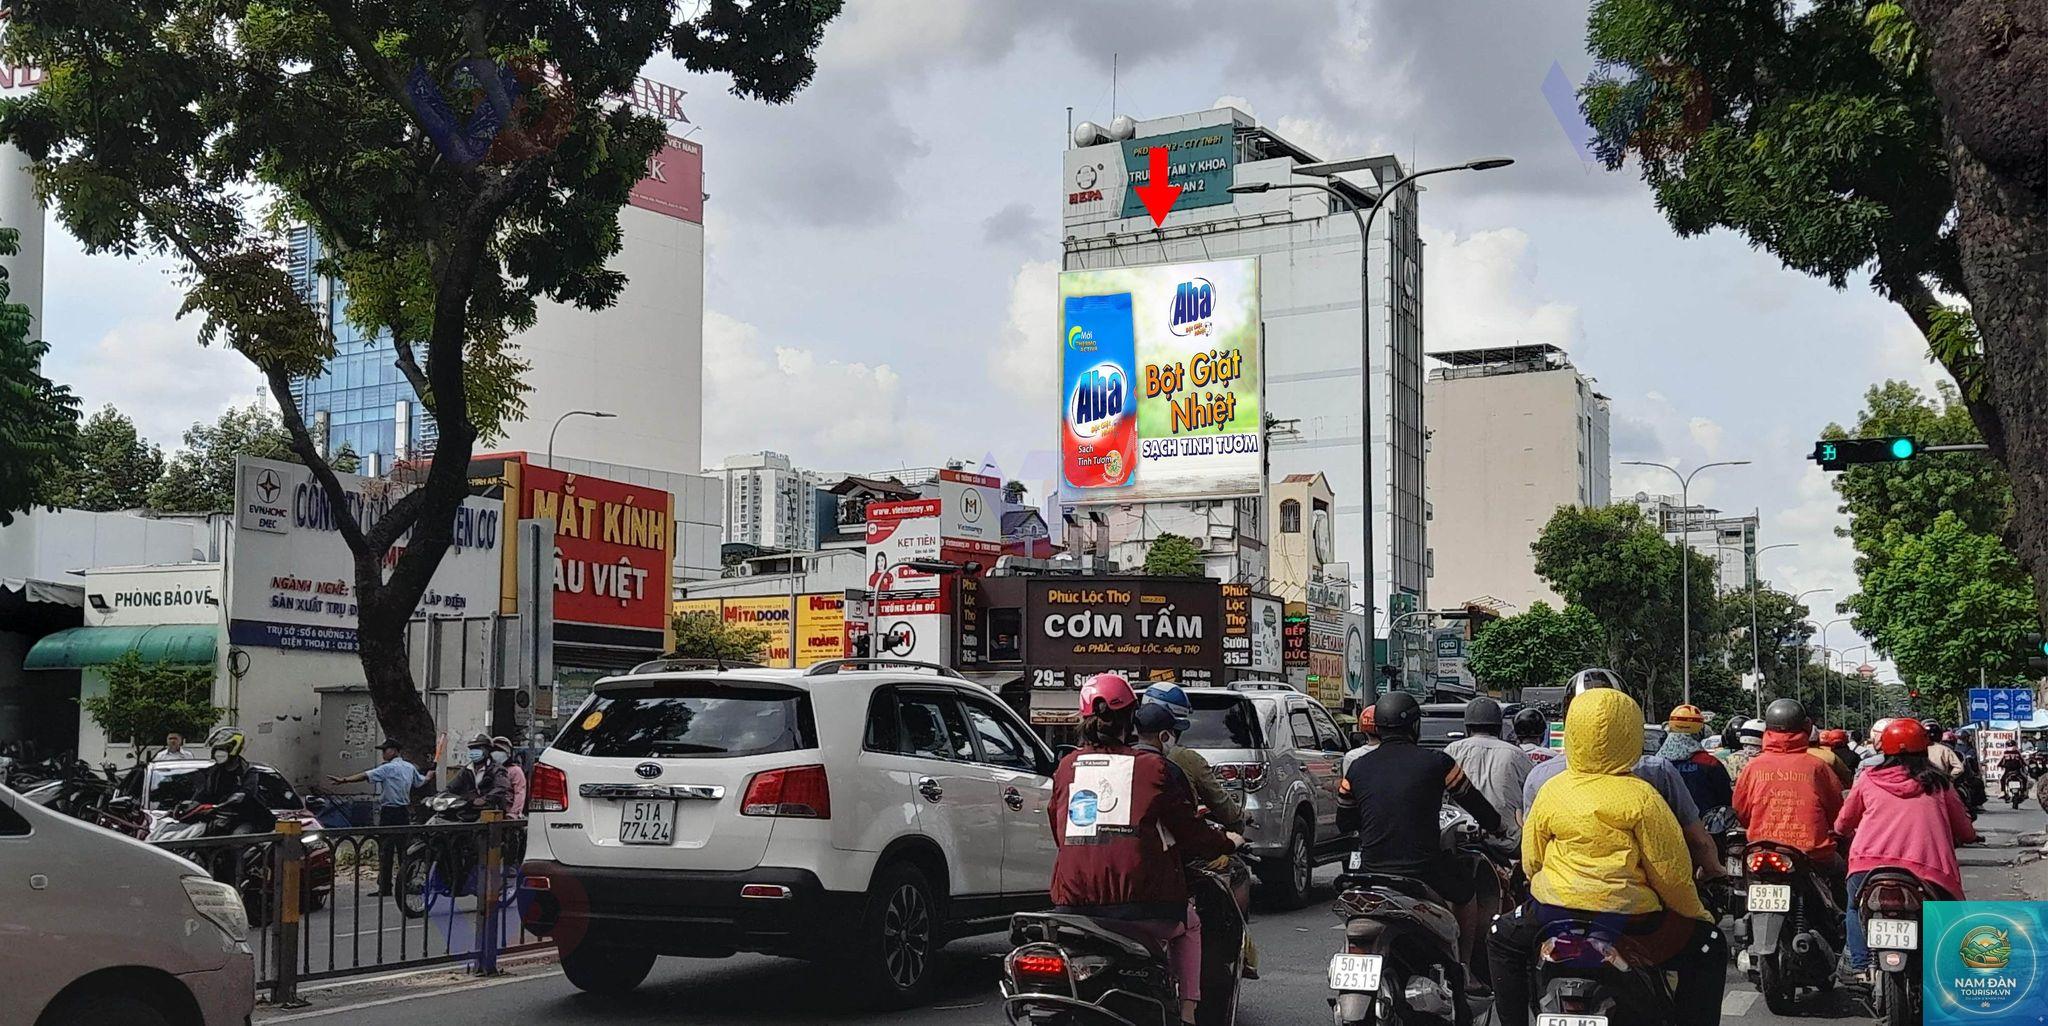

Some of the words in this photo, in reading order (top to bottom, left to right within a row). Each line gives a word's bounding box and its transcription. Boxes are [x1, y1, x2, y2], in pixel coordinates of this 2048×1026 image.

[1198, 158, 1226, 171] KHOA
[1198, 179, 1205, 191] 2
[1173, 281, 1212, 326] Aba
[1145, 361, 1185, 401] Bột
[1189, 348, 1242, 388] Giặt
[1077, 369, 1123, 425] Aba
[1170, 391, 1237, 434] Nhiệt
[1142, 439, 1178, 461] SẠCH
[1179, 436, 1214, 456] TINH
[533, 473, 597, 540] MẮT
[603, 494, 666, 550] KÍNH
[592, 555, 649, 608] VIỆT
[1222, 584, 1249, 597] Phúc
[115, 587, 161, 607] PHÒNG
[164, 583, 193, 606] BẢO
[1048, 589, 1080, 603] Phúc
[1081, 590, 1104, 605] Lộc
[1106, 589, 1131, 605] Thọ
[1226, 599, 1246, 613] Lộc
[1044, 609, 1123, 638] CƠM
[1135, 604, 1203, 638] TẤM
[1225, 613, 1248, 627] Thọ
[1222, 636, 1249, 649] Sườn
[634, 802, 661, 821] 51A
[622, 821, 669, 841] 774.24
[1750, 898, 1788, 911] 520.52
[1875, 933, 1910, 947] 8719
[1334, 972, 1378, 988] 625.15
